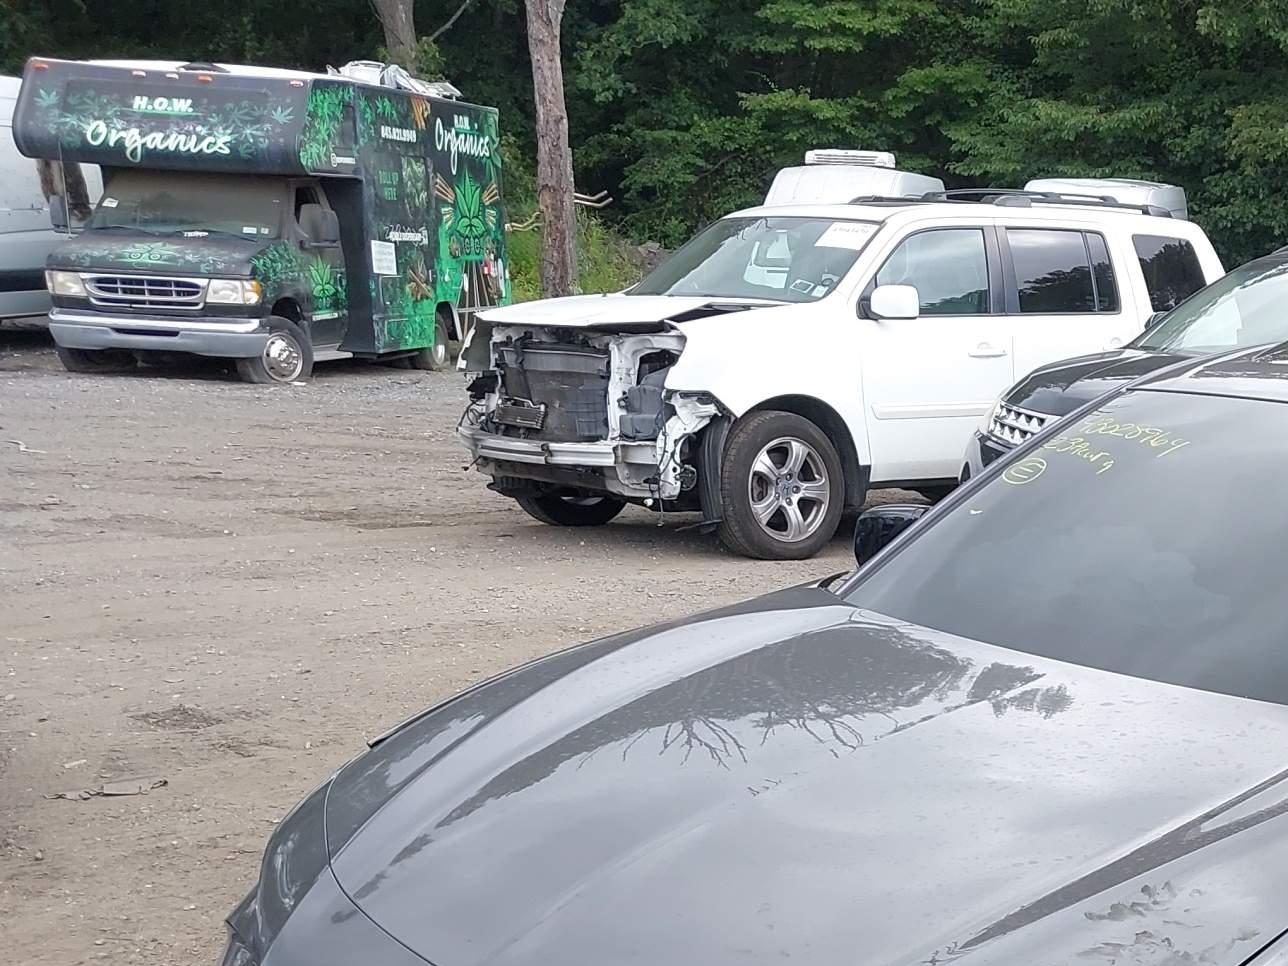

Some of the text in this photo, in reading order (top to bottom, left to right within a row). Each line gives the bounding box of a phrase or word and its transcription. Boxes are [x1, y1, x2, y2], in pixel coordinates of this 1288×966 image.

[133, 95, 194, 112] H.O.W.
[87, 121, 231, 162] Organics
[435, 117, 490, 175] Organics
